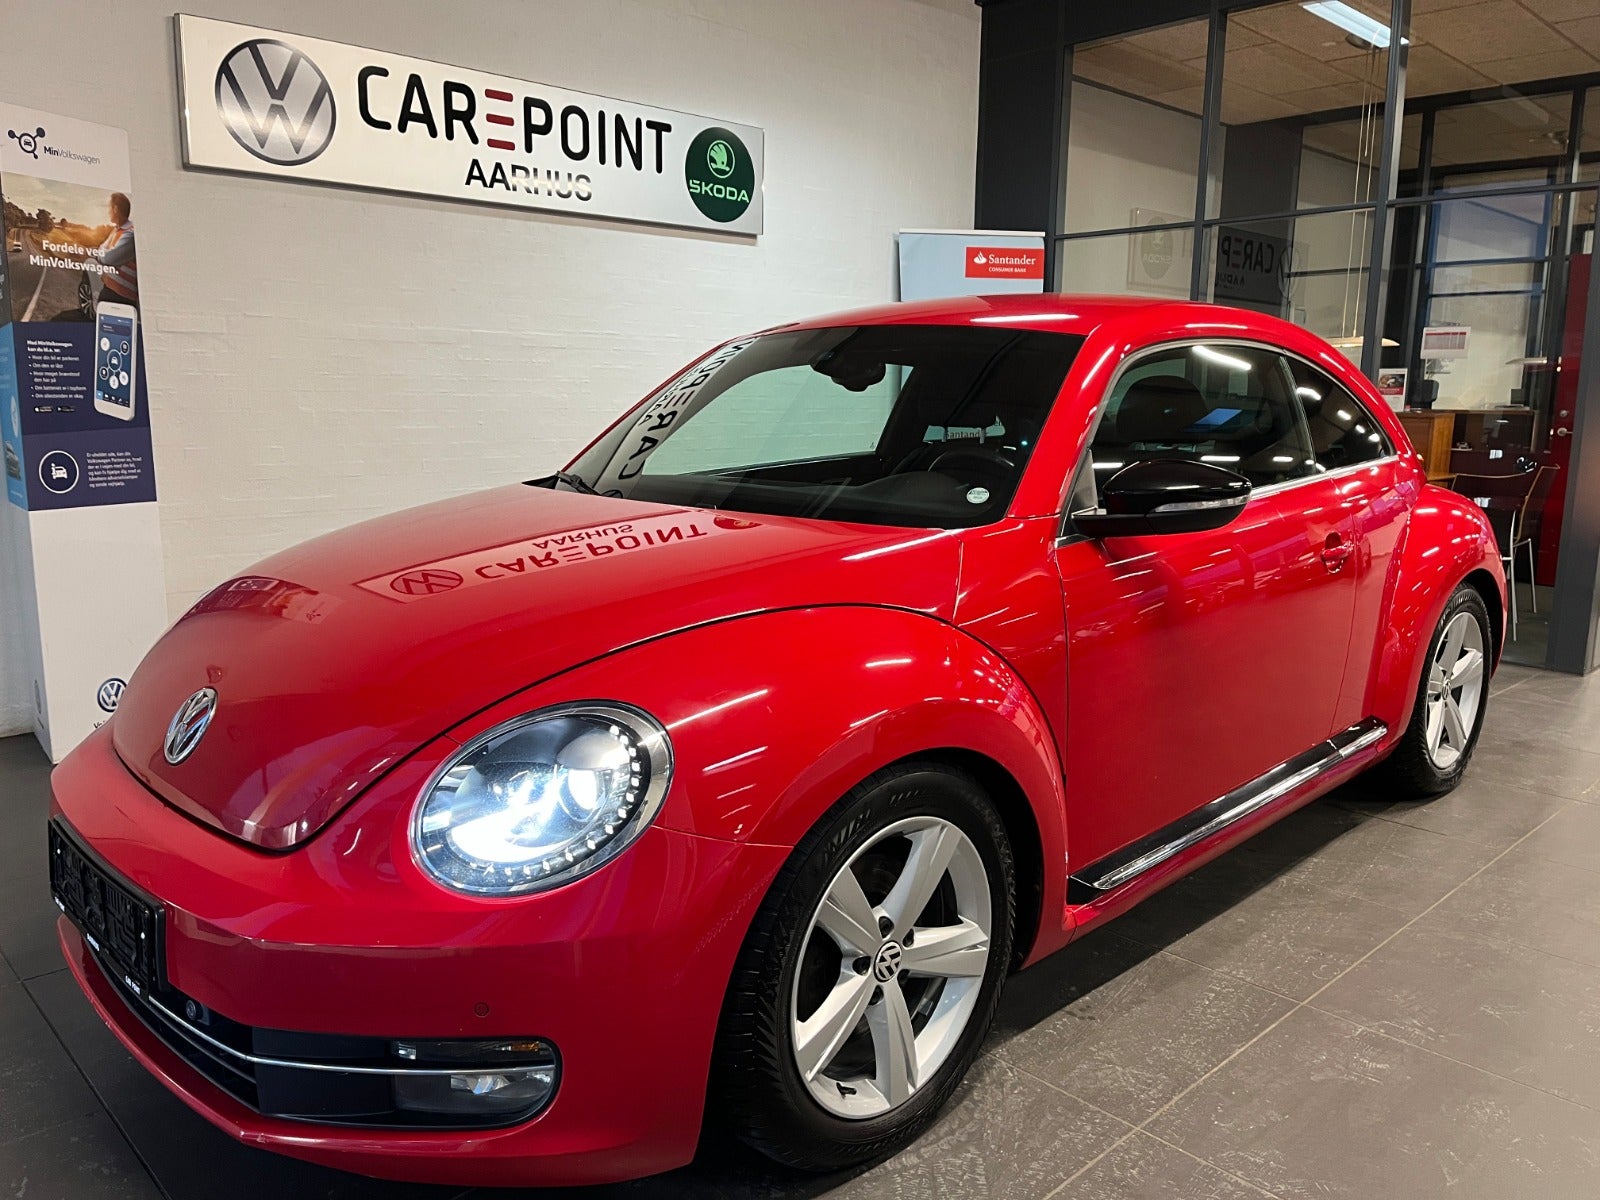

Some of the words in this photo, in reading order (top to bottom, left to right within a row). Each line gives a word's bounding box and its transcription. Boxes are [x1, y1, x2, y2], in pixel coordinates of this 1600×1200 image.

[358, 65, 672, 174] CAREPOINT
[43, 146, 100, 165] MinVolkswagen
[465, 158, 592, 202] AARHUS
[42, 240, 87, 255] Fordele
[85, 246, 105, 257] ved
[29, 254, 119, 275] MinVolkswagen.
[988, 253, 1036, 265] Santander
